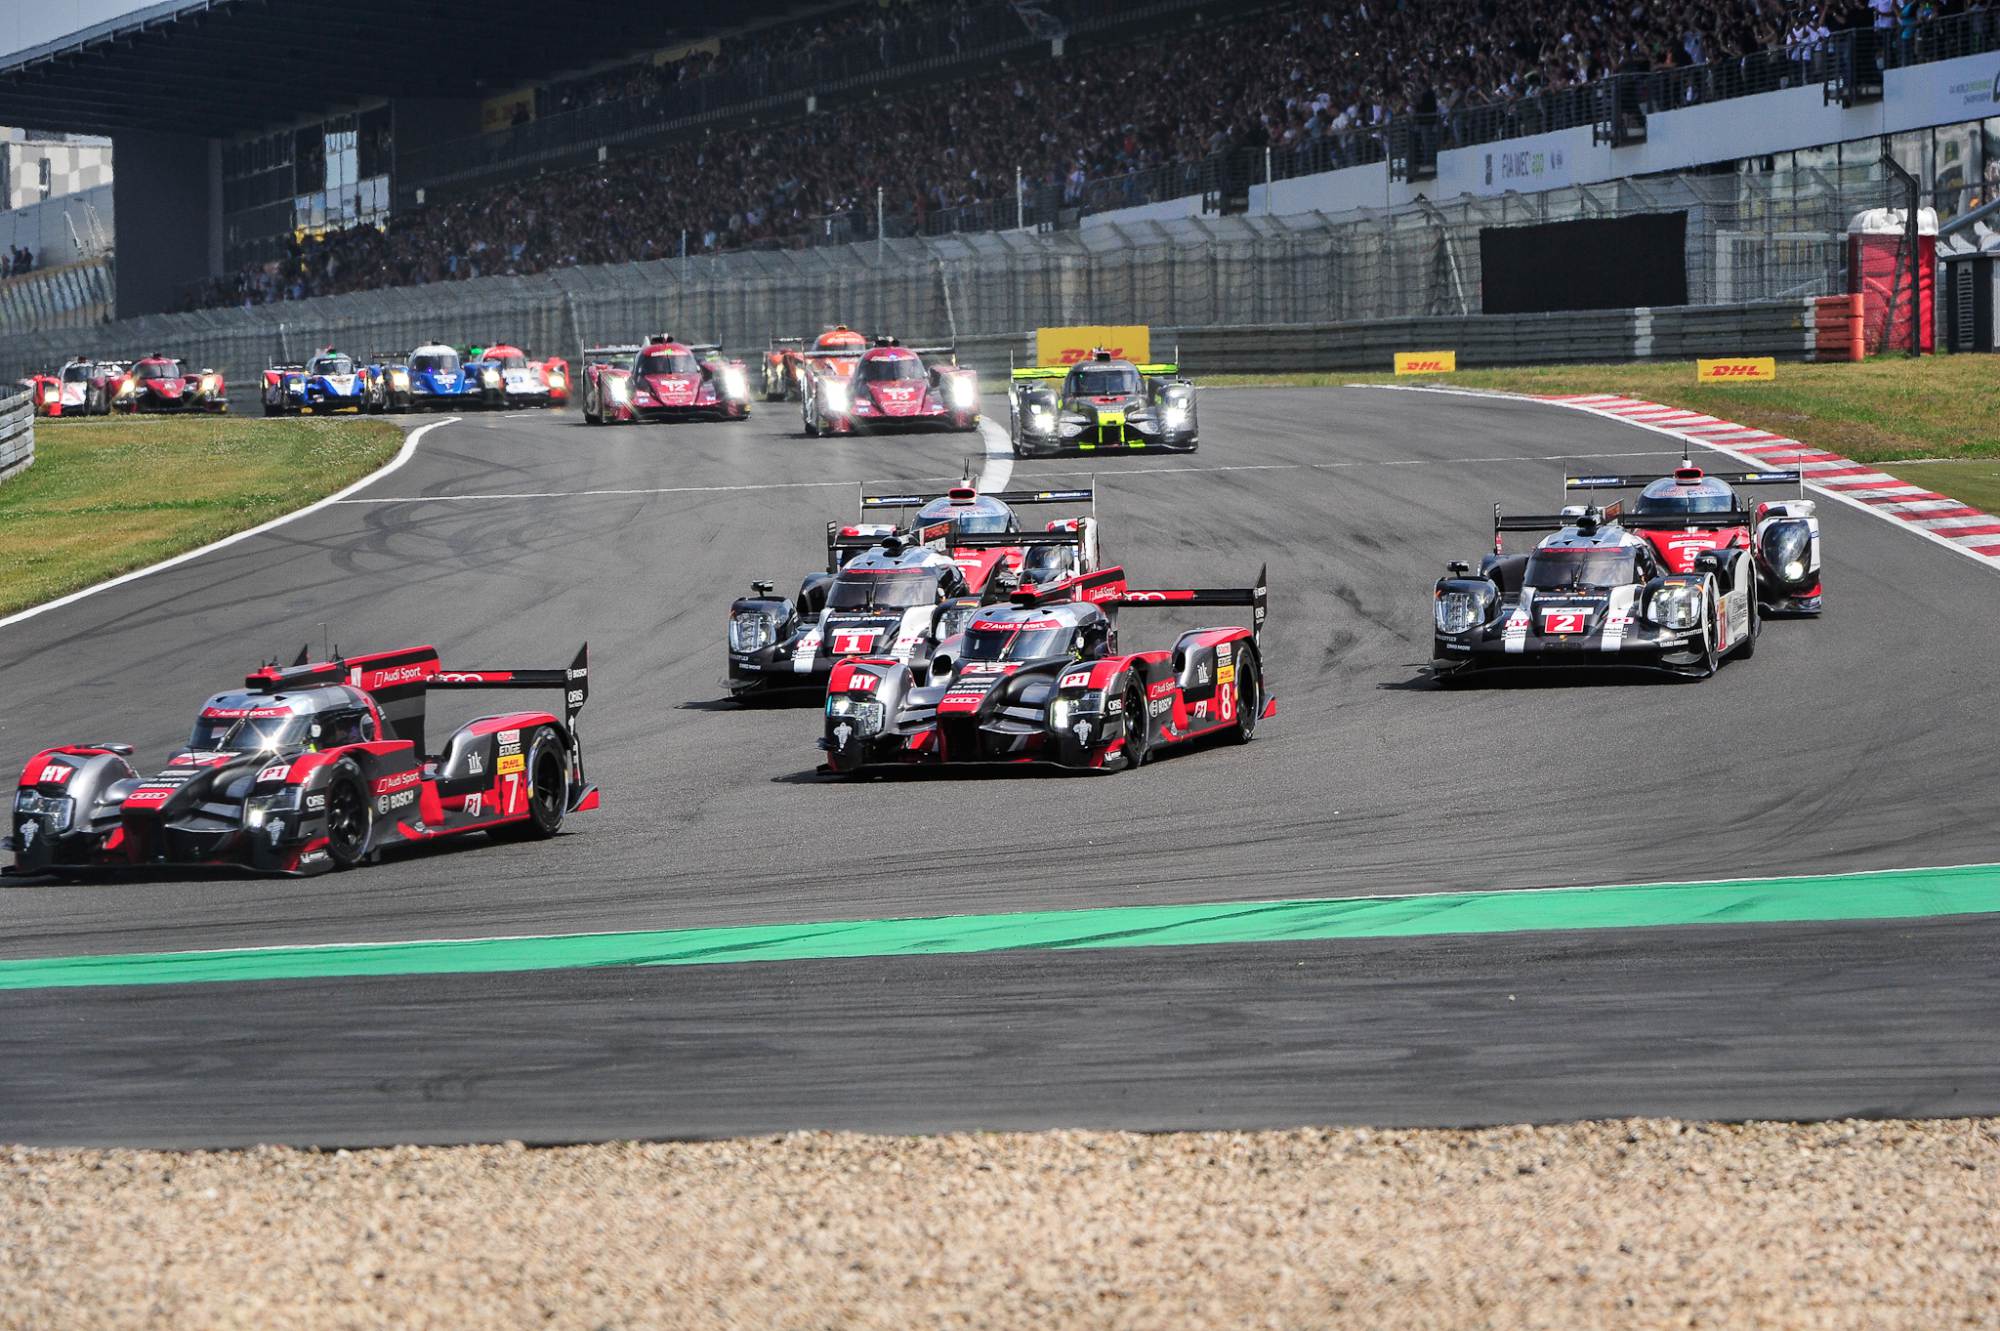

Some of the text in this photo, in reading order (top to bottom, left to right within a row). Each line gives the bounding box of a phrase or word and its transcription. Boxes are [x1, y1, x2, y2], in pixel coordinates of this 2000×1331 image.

[1408, 361, 1443, 371] DHL
[1711, 365, 1761, 376] DHL
[669, 383, 686, 392] 12
[890, 391, 910, 400] 13
[1683, 547, 1699, 561] 5
[992, 621, 1046, 631] Audi Sport
[1553, 615, 1576, 632] 2
[844, 636, 860, 652] 1
[384, 666, 421, 682] Audi Sport
[1065, 674, 1085, 685] P1
[849, 674, 877, 689] HY
[567, 690, 584, 703] ORIS
[1221, 683, 1232, 720] 8
[241, 708, 276, 718] Sport
[499, 743, 521, 756] EDGE
[39, 765, 71, 782] HY
[262, 767, 284, 779] P1
[387, 772, 420, 789] Audi Sport
[390, 790, 414, 810] BOSCH
[505, 773, 519, 814] 7
[306, 795, 325, 807] ORIS
